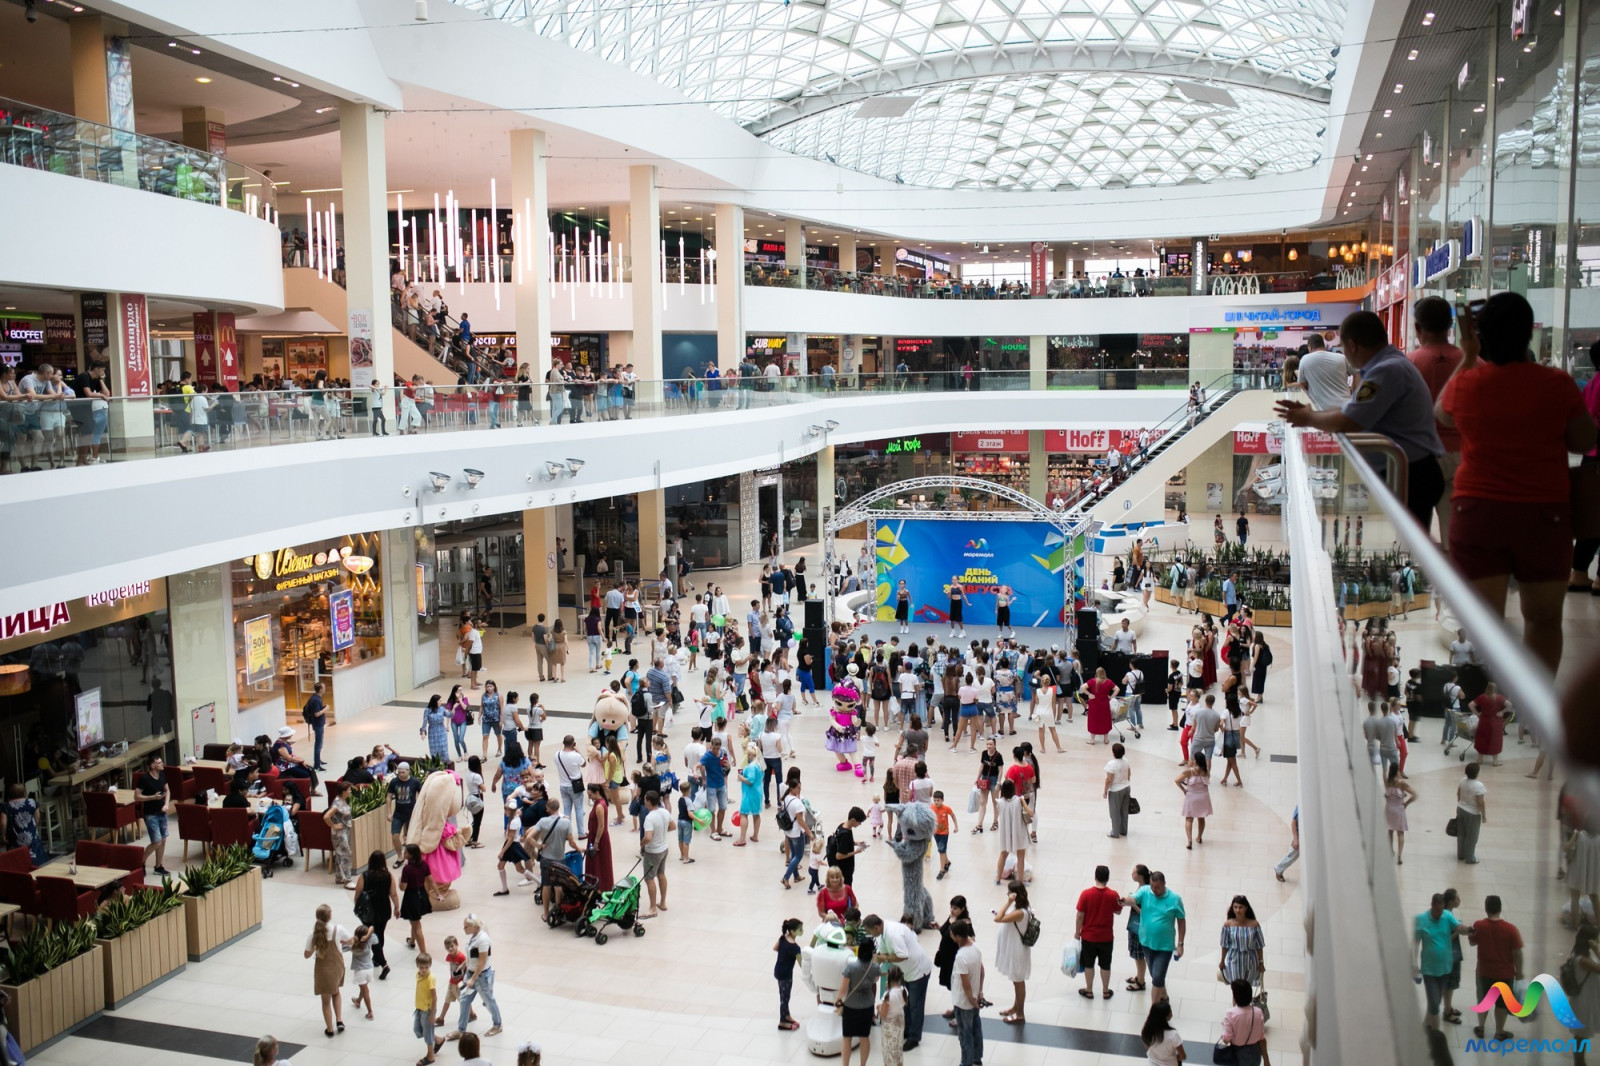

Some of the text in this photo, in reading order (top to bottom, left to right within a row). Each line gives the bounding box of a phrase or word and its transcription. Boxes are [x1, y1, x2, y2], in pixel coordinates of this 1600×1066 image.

[1244, 308, 1321, 321] ЧИТАЙ-ГОРОД
[126, 303, 137, 372] Леонардо
[752, 338, 786, 349] SUBWAY
[140, 380, 148, 392] 2
[1070, 430, 1106, 448] Hoff
[965, 568, 991, 576] ДЕНЬ
[276, 568, 339, 591] ФИРМЕННЫЙ МАГАЗИН
[958, 575, 998, 584] ЗНАНИЙ
[252, 637, 266, 648] 500
